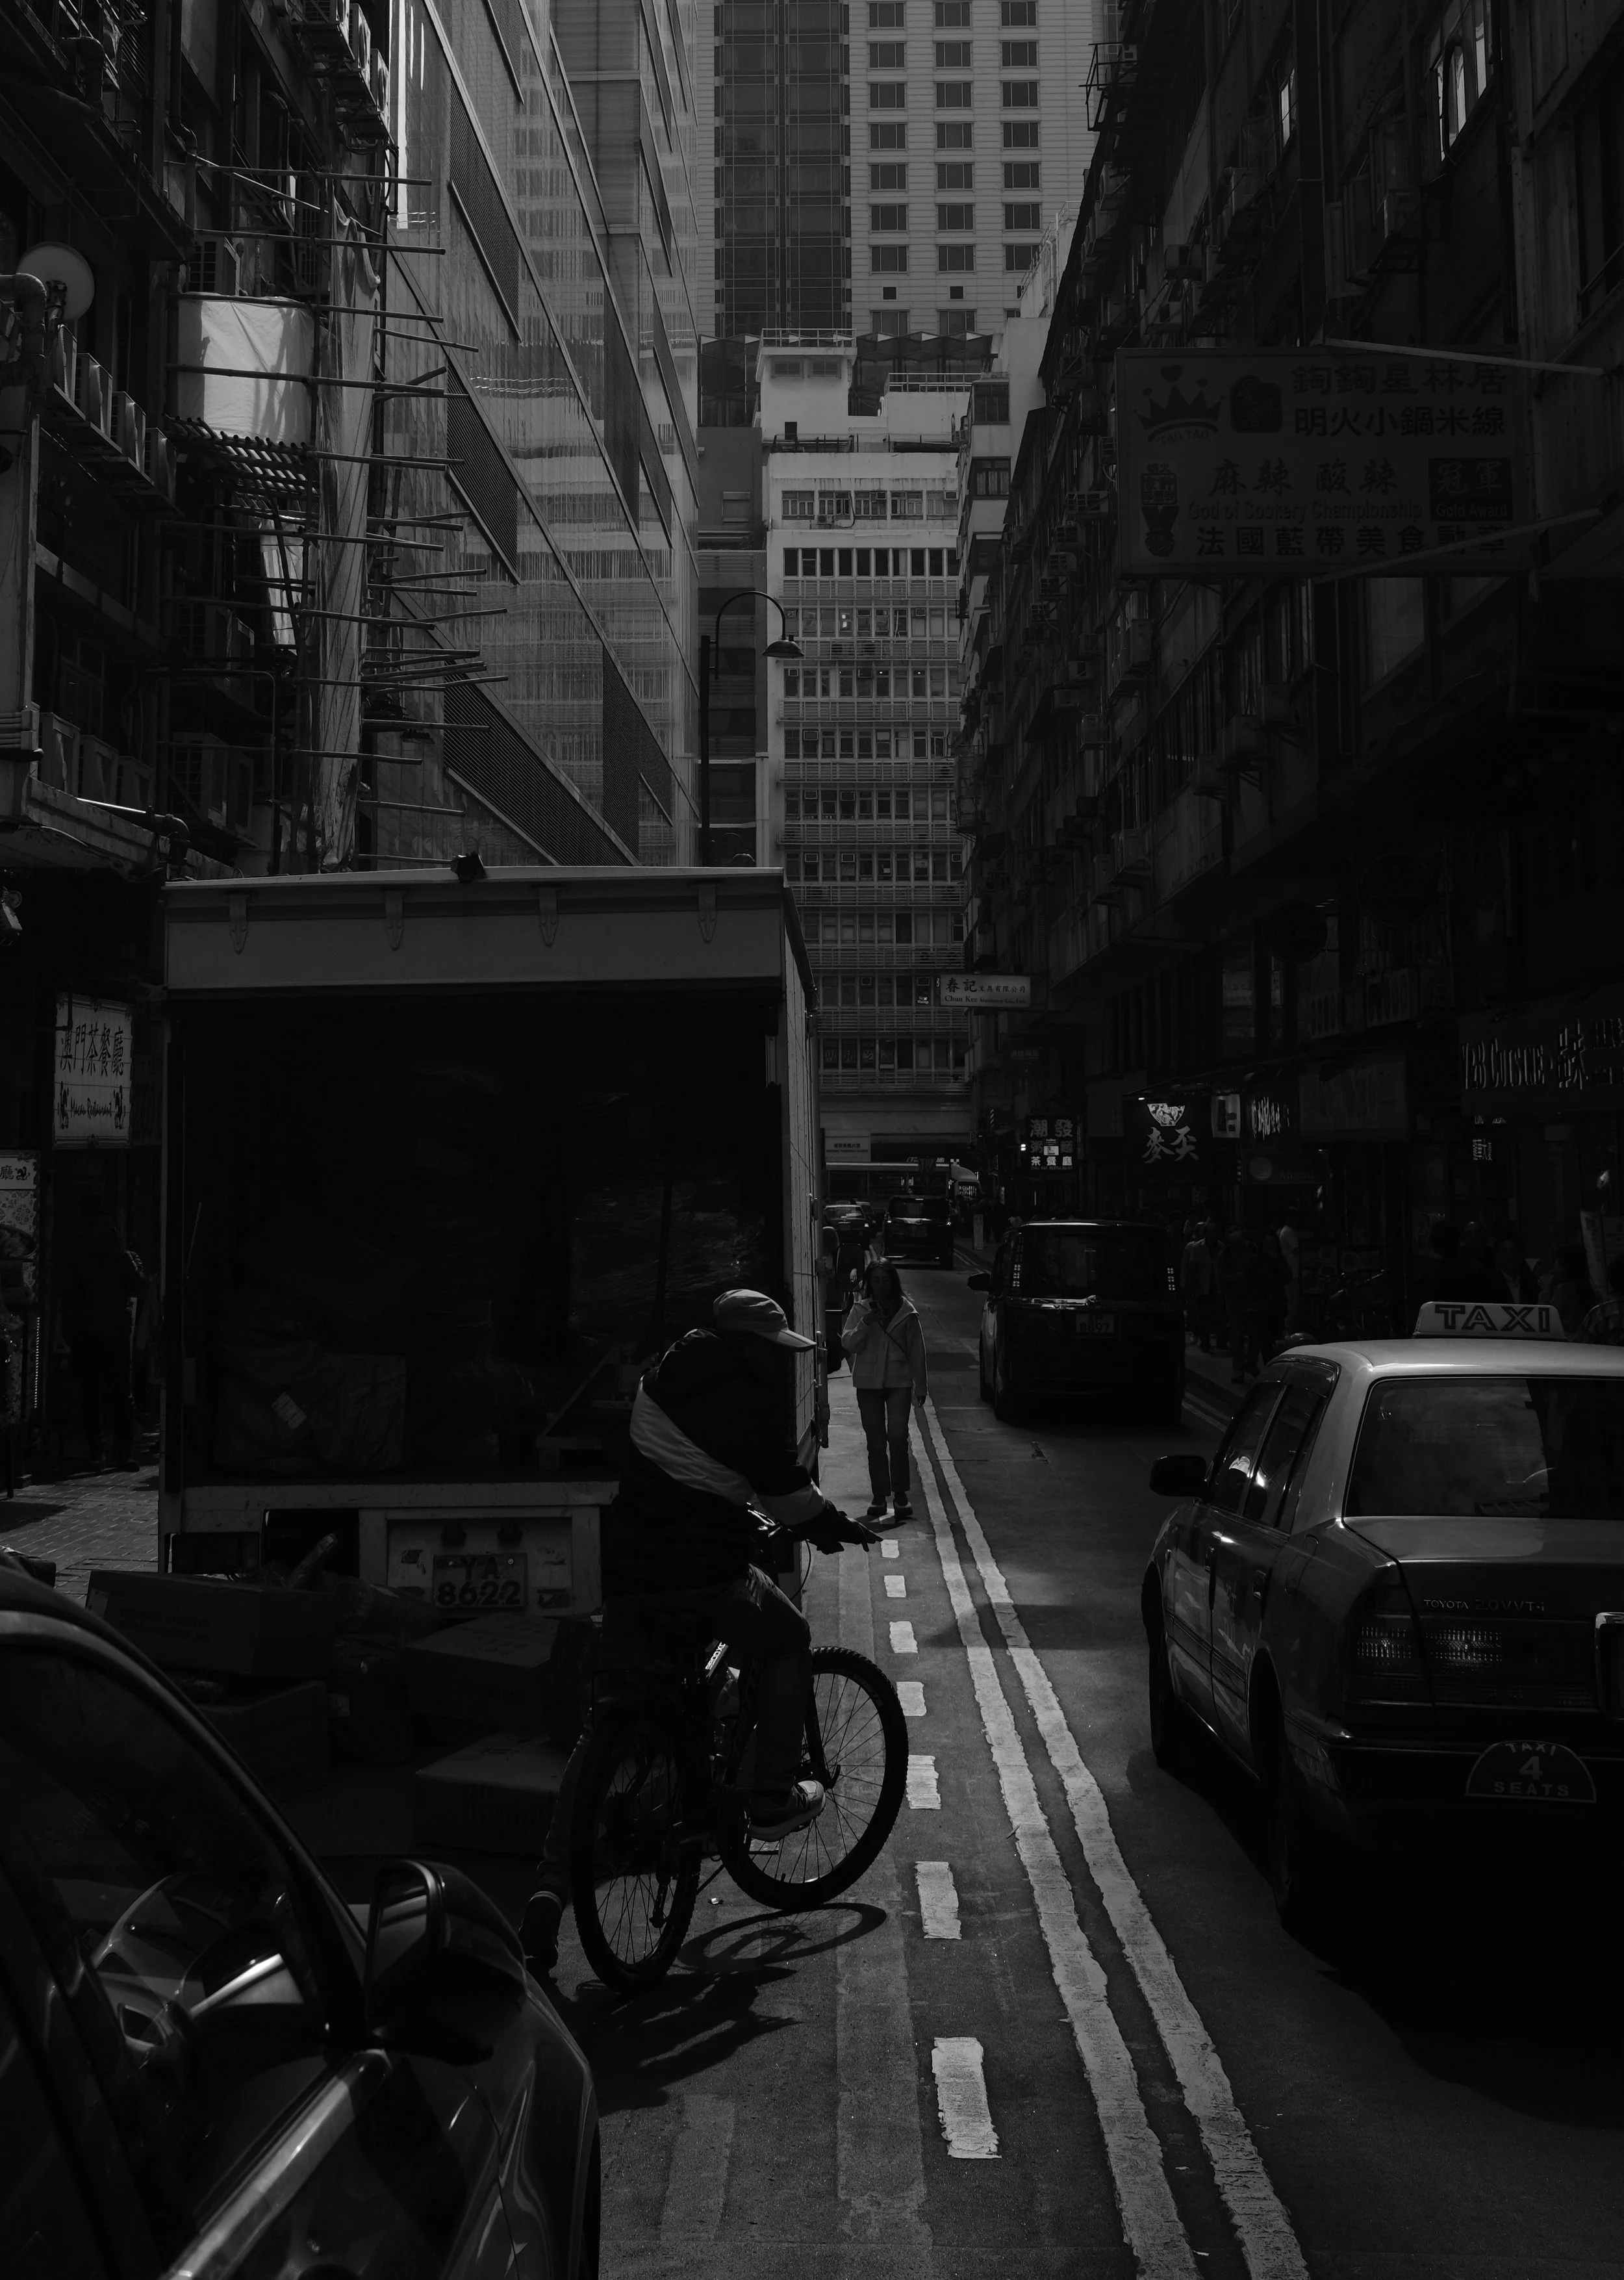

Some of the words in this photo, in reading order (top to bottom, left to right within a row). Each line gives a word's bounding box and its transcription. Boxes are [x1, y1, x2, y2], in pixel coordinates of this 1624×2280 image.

[1295, 405, 1505, 437] 明火小鍋米線
[1187, 429, 1210, 441] TAO
[1208, 457, 1294, 496] 麻辣
[1316, 456, 1399, 496] 酸辣
[1437, 460, 1502, 495] 冠軍
[1188, 501, 1219, 520] God
[1224, 501, 1239, 520] of
[1243, 501, 1307, 524] Cookery
[1311, 498, 1425, 524] Championship
[1436, 502, 1465, 518] Gold
[1468, 500, 1508, 518] Award
[1434, 1304, 1550, 1333] TAXI
[460, 1557, 500, 1580] YA
[437, 1580, 521, 1606] 8622
[1423, 1598, 1469, 1610] TOYOTA
[1504, 1742, 1556, 1756] TAXI
[1519, 1755, 1543, 1780] 4
[1493, 1780, 1569, 1797] SEATS
